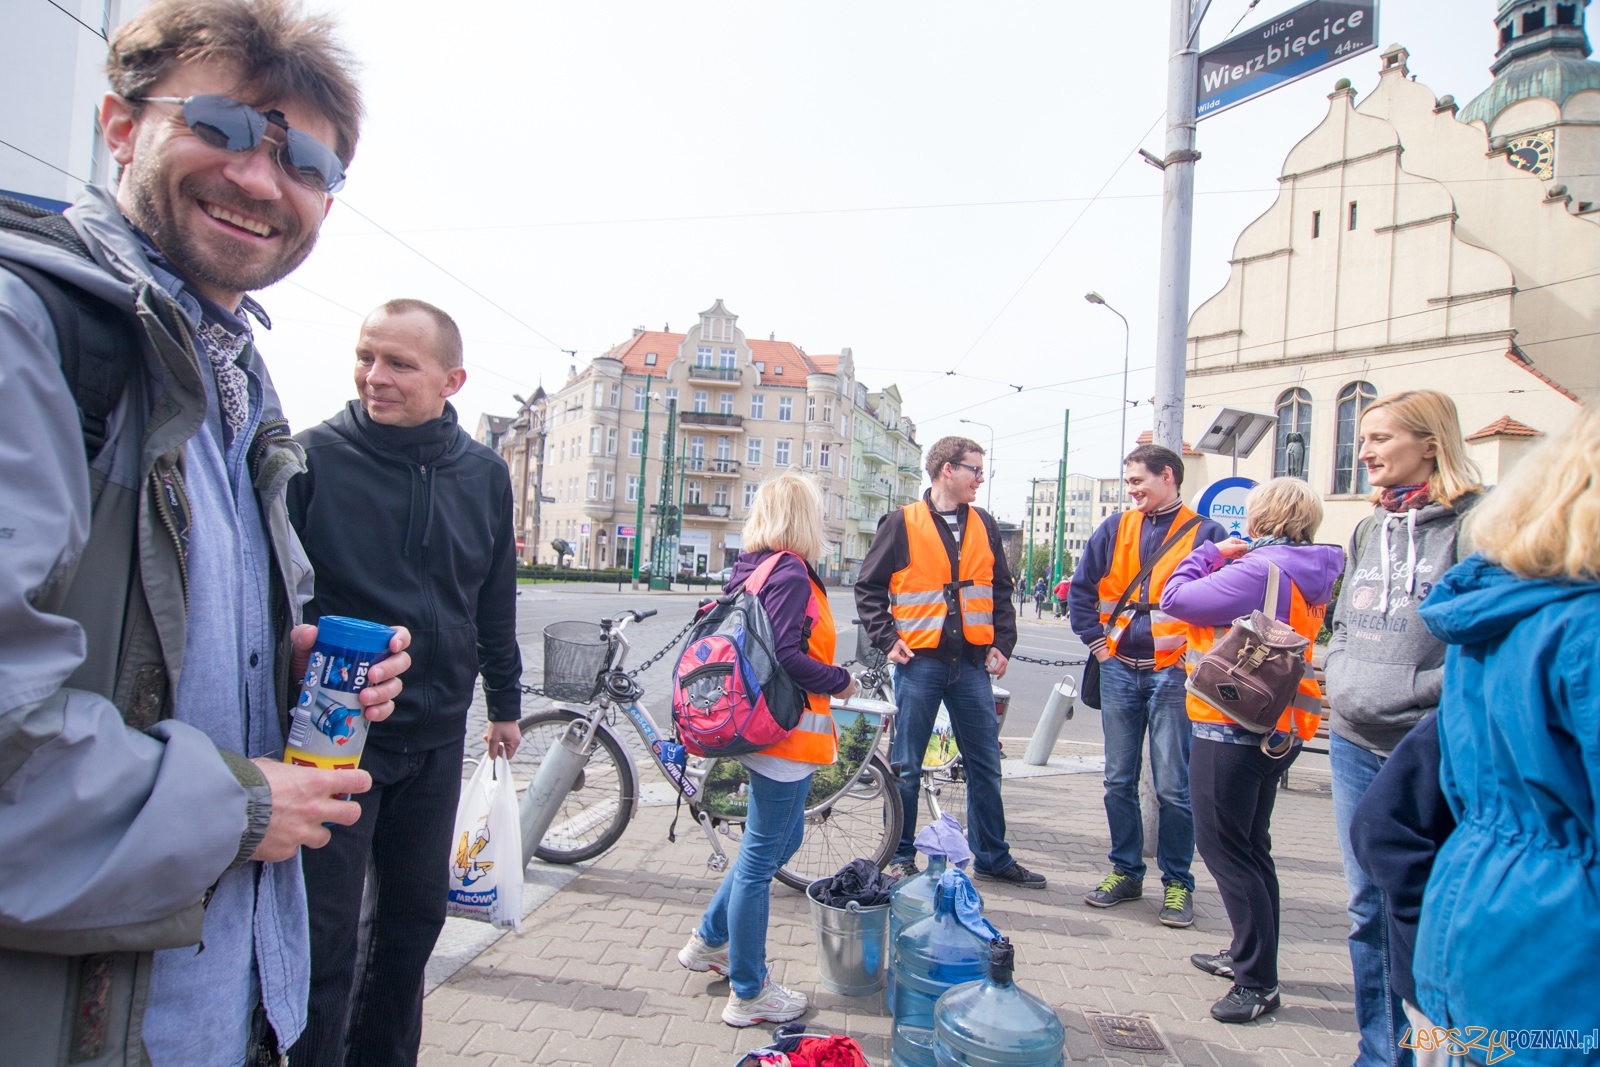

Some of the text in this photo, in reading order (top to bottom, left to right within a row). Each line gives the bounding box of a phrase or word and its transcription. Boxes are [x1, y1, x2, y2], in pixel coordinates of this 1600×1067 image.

[1263, 18, 1294, 39] ulica
[1202, 9, 1364, 93] Wierzbięcice
[1197, 99, 1220, 113] Wilda
[1212, 503, 1245, 516] PRM
[729, 799, 749, 807] austr
